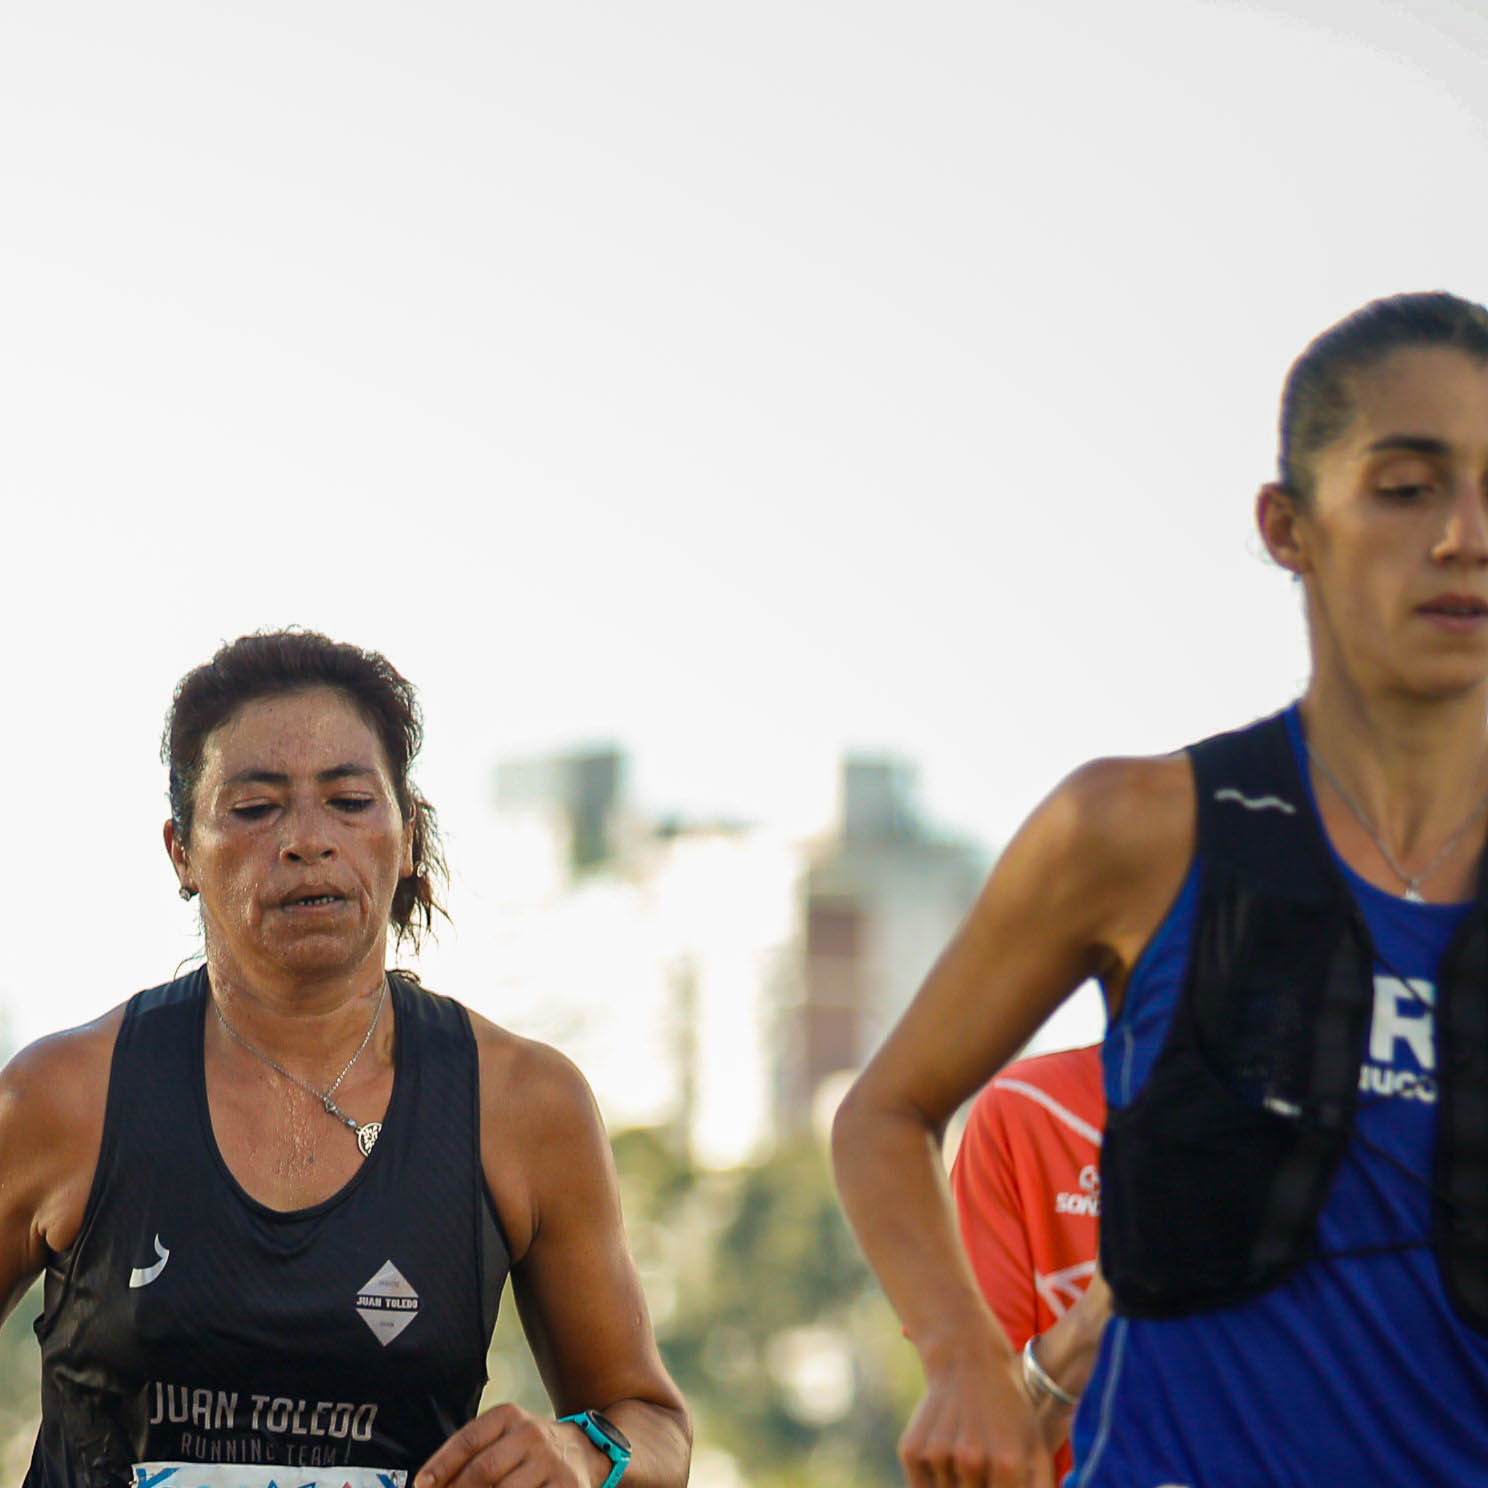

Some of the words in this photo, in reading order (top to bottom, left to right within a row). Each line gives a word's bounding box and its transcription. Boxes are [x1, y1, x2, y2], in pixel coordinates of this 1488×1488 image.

[356, 1296, 382, 1307] JUAN
[385, 1298, 419, 1309] TOLEDO
[150, 1381, 239, 1431] JUAN
[251, 1394, 379, 1442] TOLEDO
